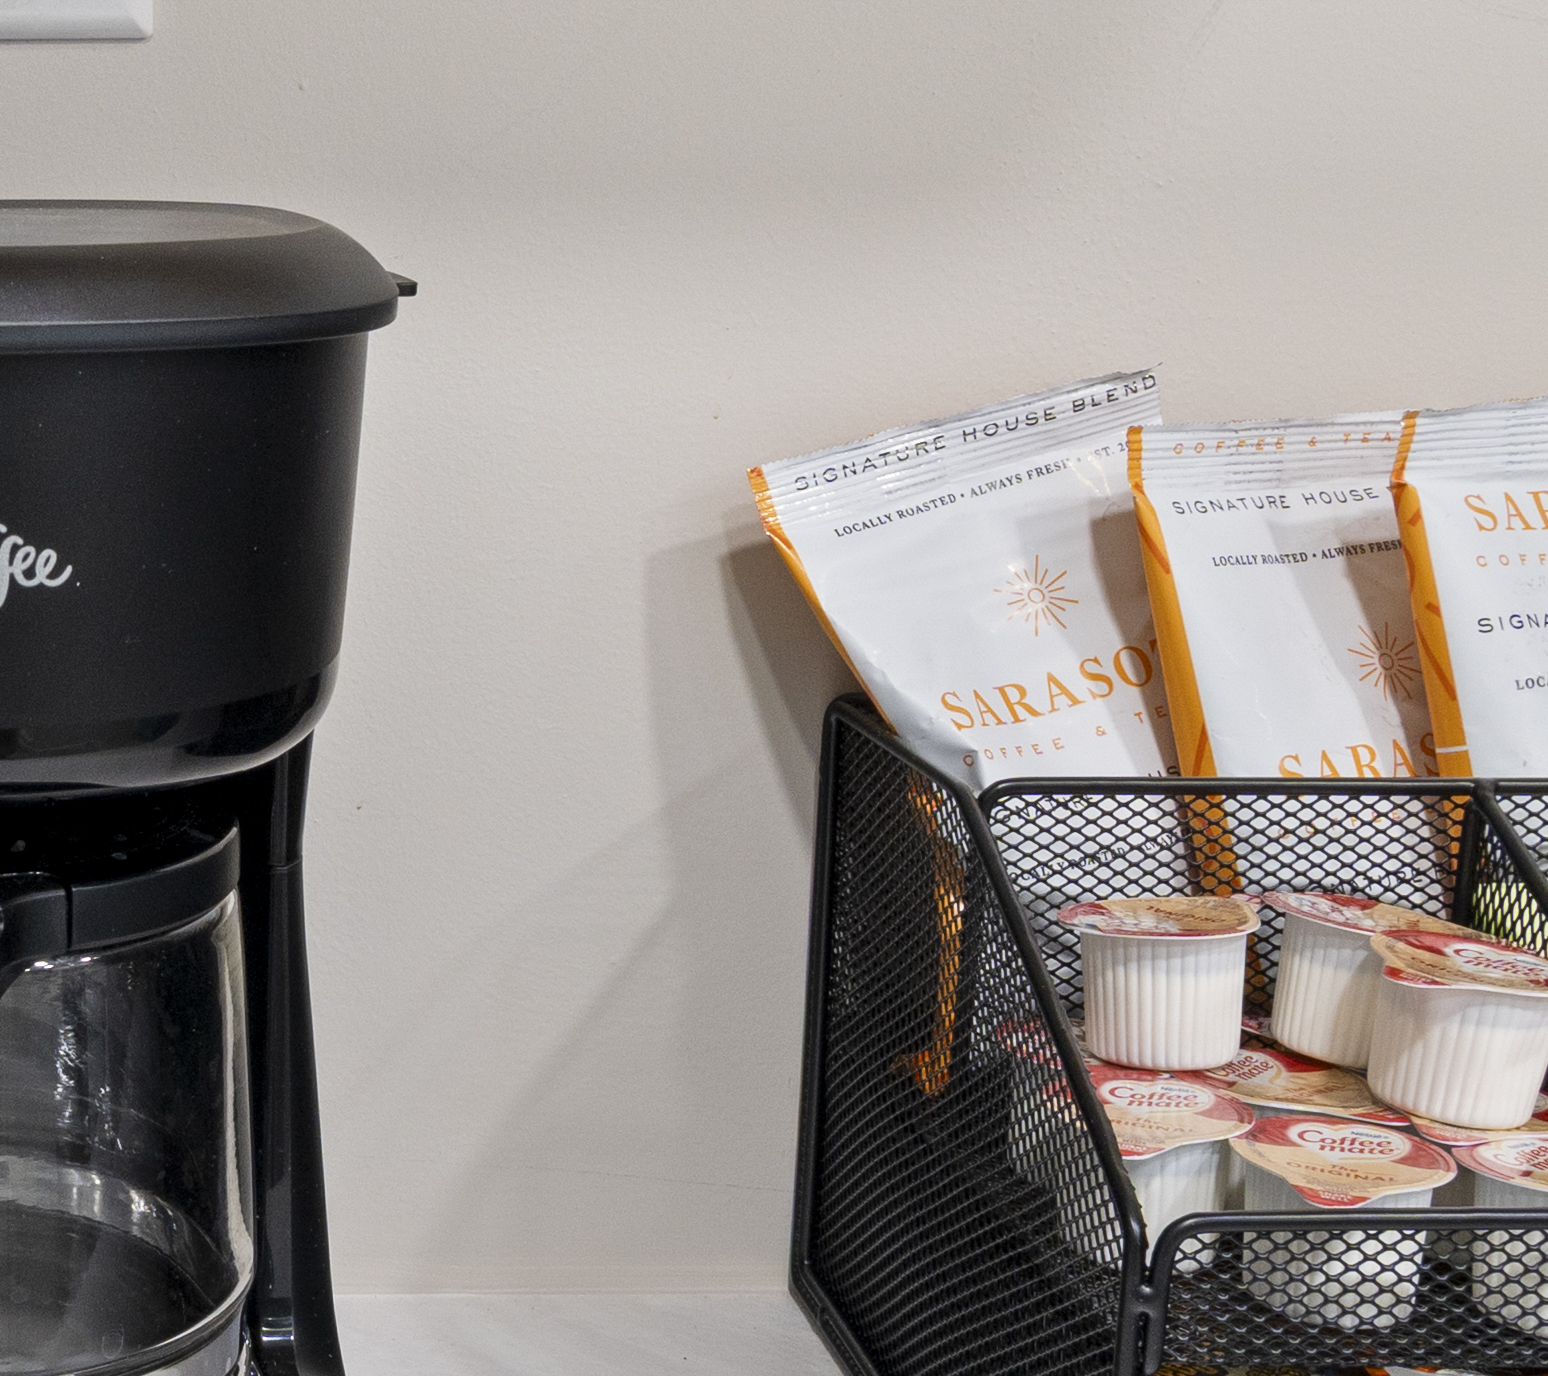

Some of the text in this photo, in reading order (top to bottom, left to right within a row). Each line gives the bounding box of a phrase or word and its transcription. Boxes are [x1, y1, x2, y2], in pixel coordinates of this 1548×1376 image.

[794, 373, 1158, 492] SIGNATURE HOUSE BLEND
[1173, 437, 1285, 455] COFFEE
[1343, 432, 1393, 445] TEA
[833, 511, 894, 538] LOCALLY
[896, 492, 958, 520] ROASTED
[969, 471, 1023, 499] ALWAYS
[1171, 486, 1380, 515] SIGNATURE HOUSE
[1212, 553, 1260, 567] LOCALLY
[1261, 551, 1309, 566] ROASTED
[1321, 544, 1366, 560] ALWAYS
[939, 637, 1160, 732] SARASO
[962, 704, 1169, 769] COFFEE & TE
[1108, 1086, 1199, 1102] Coffee
[1127, 1099, 1199, 1109] mate
[1110, 1118, 1194, 1133] RIGINAL
[1296, 1129, 1393, 1147] Coffee
[1317, 1144, 1395, 1155] mate
[1286, 1161, 1398, 1182] ORIGINAL
[1331, 1163, 1359, 1173] The
